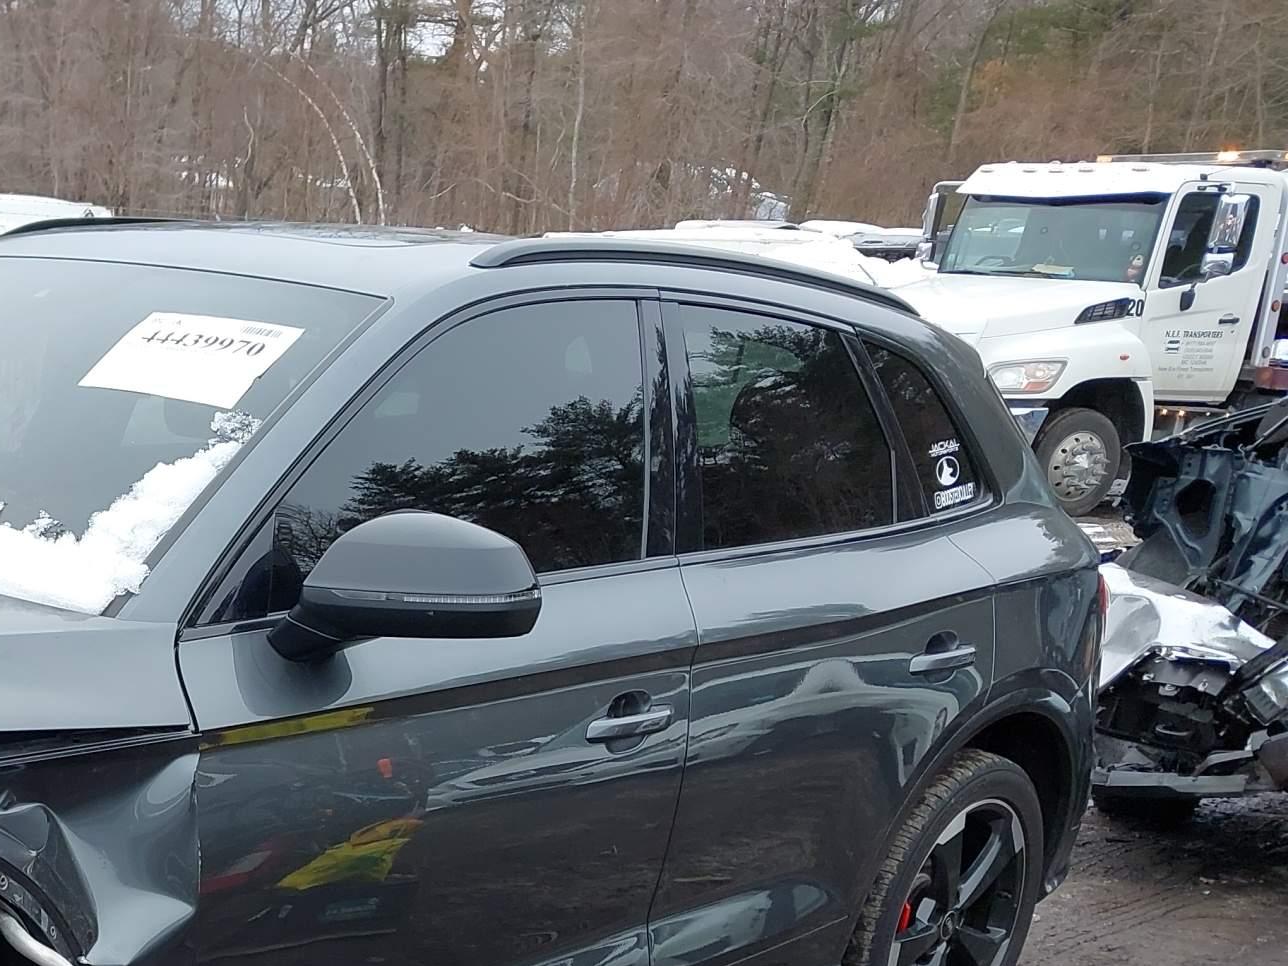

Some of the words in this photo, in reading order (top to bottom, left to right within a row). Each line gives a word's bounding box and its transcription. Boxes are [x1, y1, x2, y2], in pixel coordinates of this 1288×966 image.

[1126, 298, 1145, 317] 20
[141, 330, 266, 356] 44439970
[1183, 330, 1224, 339] TRANSPORTERS
[929, 438, 960, 454] JACKAL
